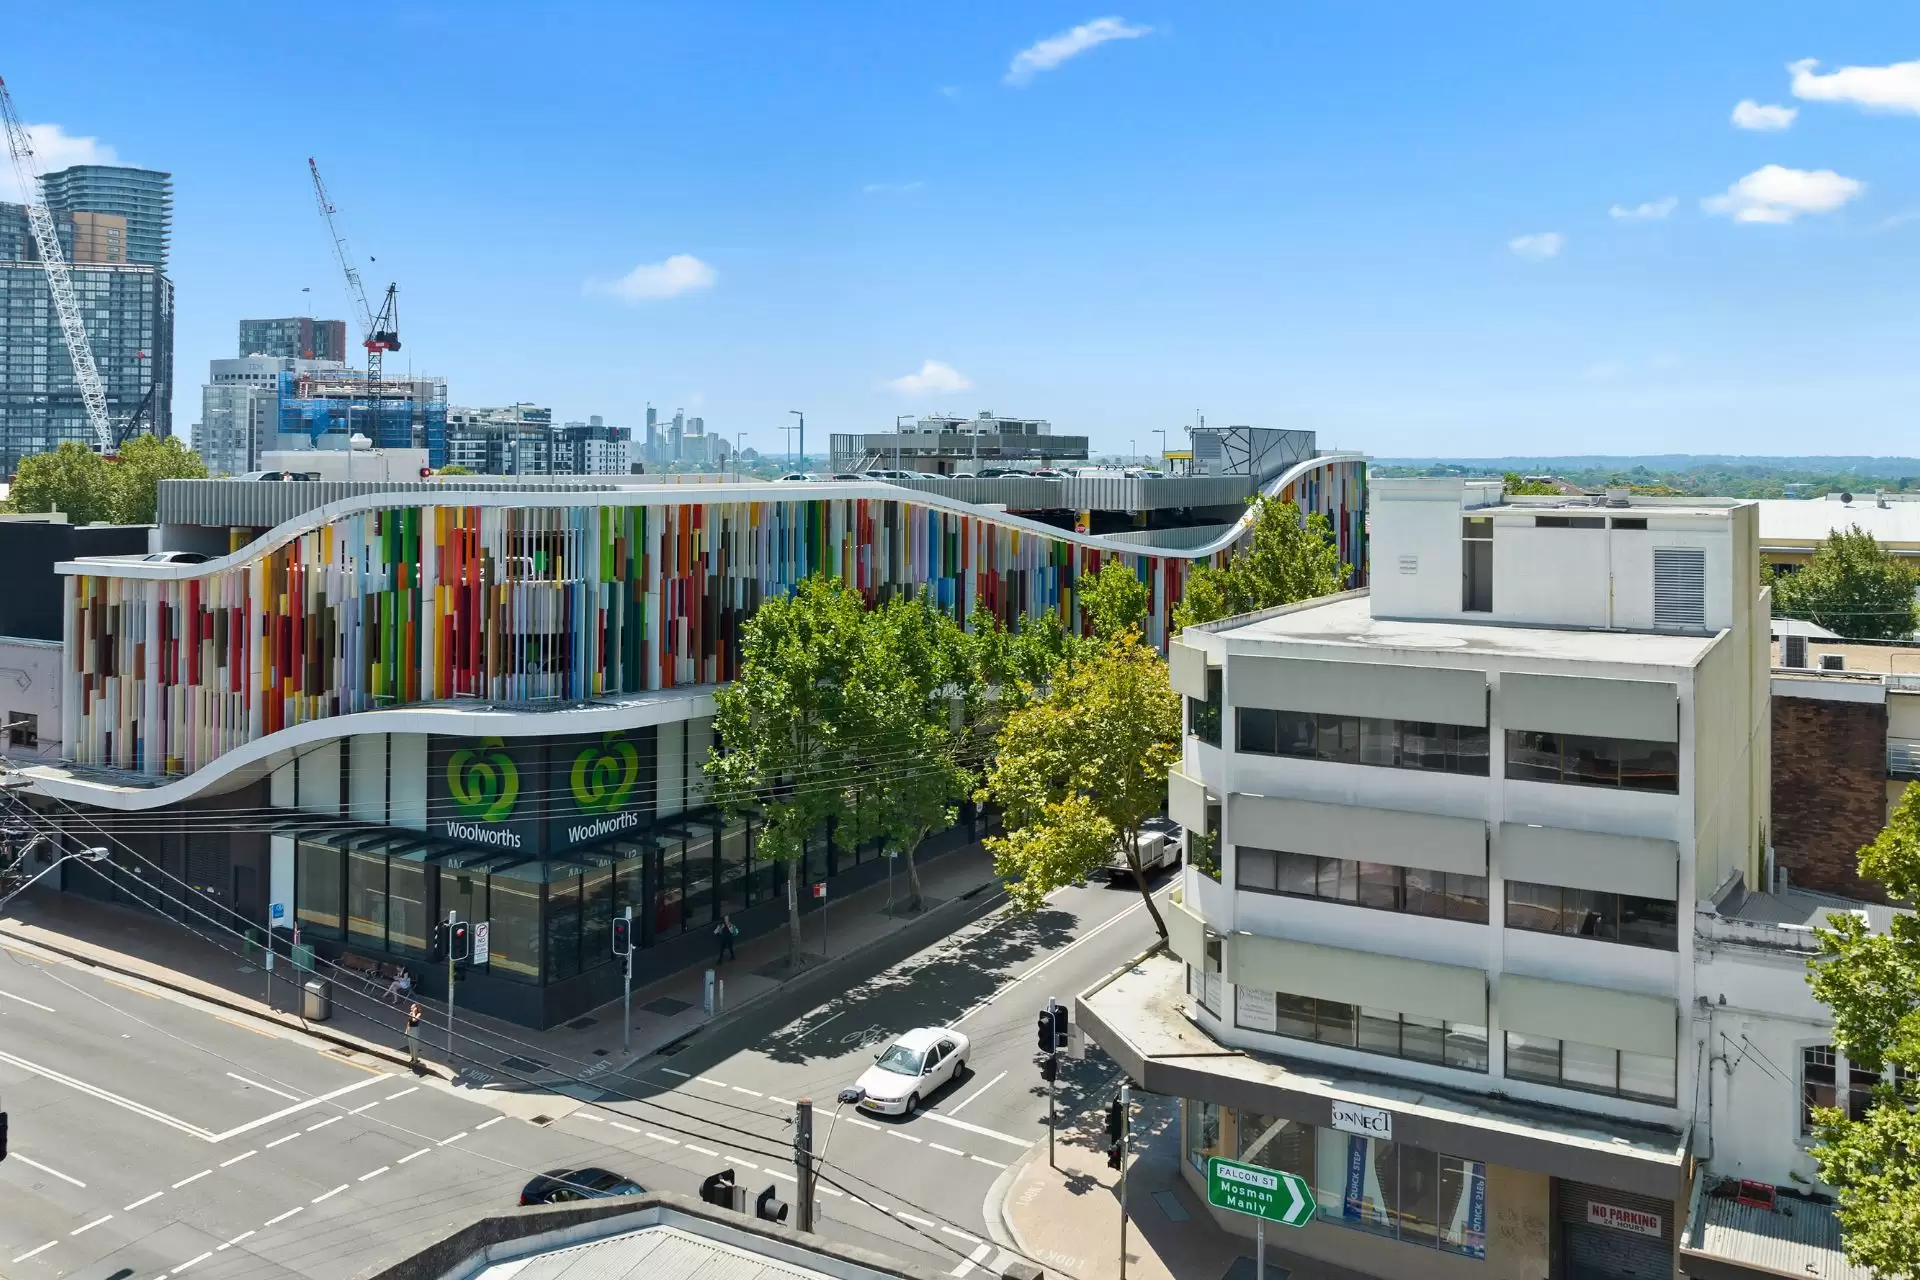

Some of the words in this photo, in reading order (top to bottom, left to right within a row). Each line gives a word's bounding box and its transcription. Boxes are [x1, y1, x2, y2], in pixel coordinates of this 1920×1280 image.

[447, 821, 521, 848] Woolworths
[568, 811, 638, 843] Woolworths
[1332, 1105, 1390, 1132] ONNECT
[1353, 1151, 1362, 1171] STEP
[1220, 1167, 1258, 1182] FALCON
[1262, 1177, 1275, 1186] ST
[1350, 1172, 1360, 1200] QUICK
[1221, 1181, 1273, 1202] Mosman
[1227, 1195, 1266, 1215] Manly
[1592, 1205, 1606, 1217] NO
[1610, 1208, 1657, 1228] PARKING
[1617, 1222, 1645, 1232] HOURS
